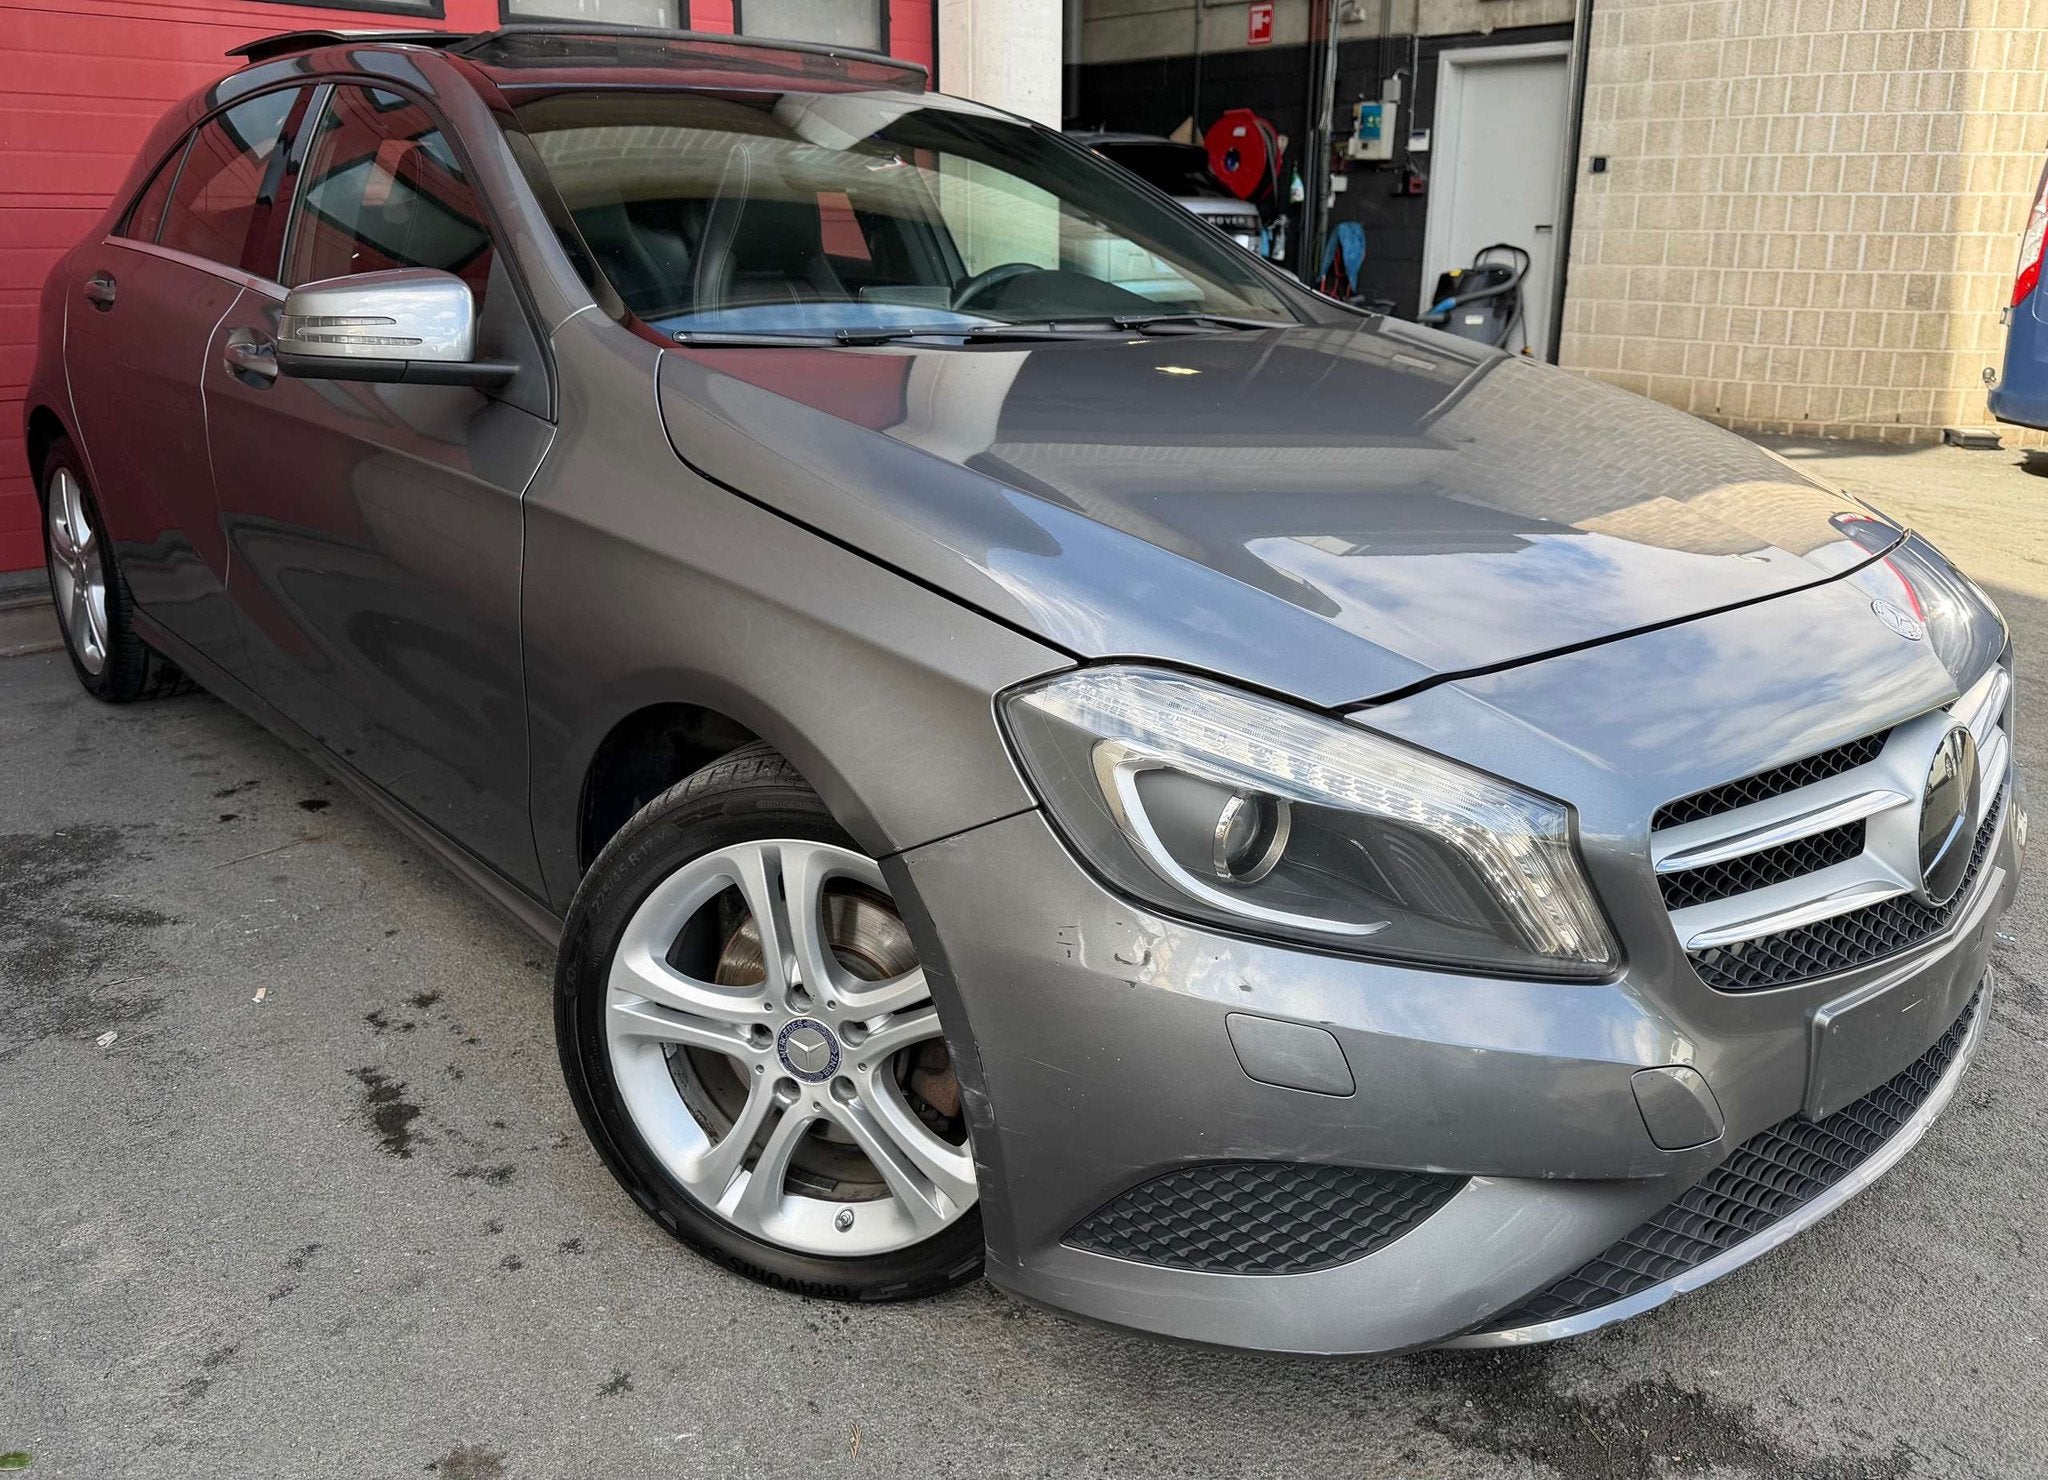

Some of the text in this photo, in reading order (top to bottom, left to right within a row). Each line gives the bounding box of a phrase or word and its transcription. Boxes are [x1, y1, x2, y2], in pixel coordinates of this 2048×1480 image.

[1208, 216, 1245, 225] ROVER
[779, 1021, 803, 1058] MERCEDES
[824, 1053, 838, 1075] BENZ
